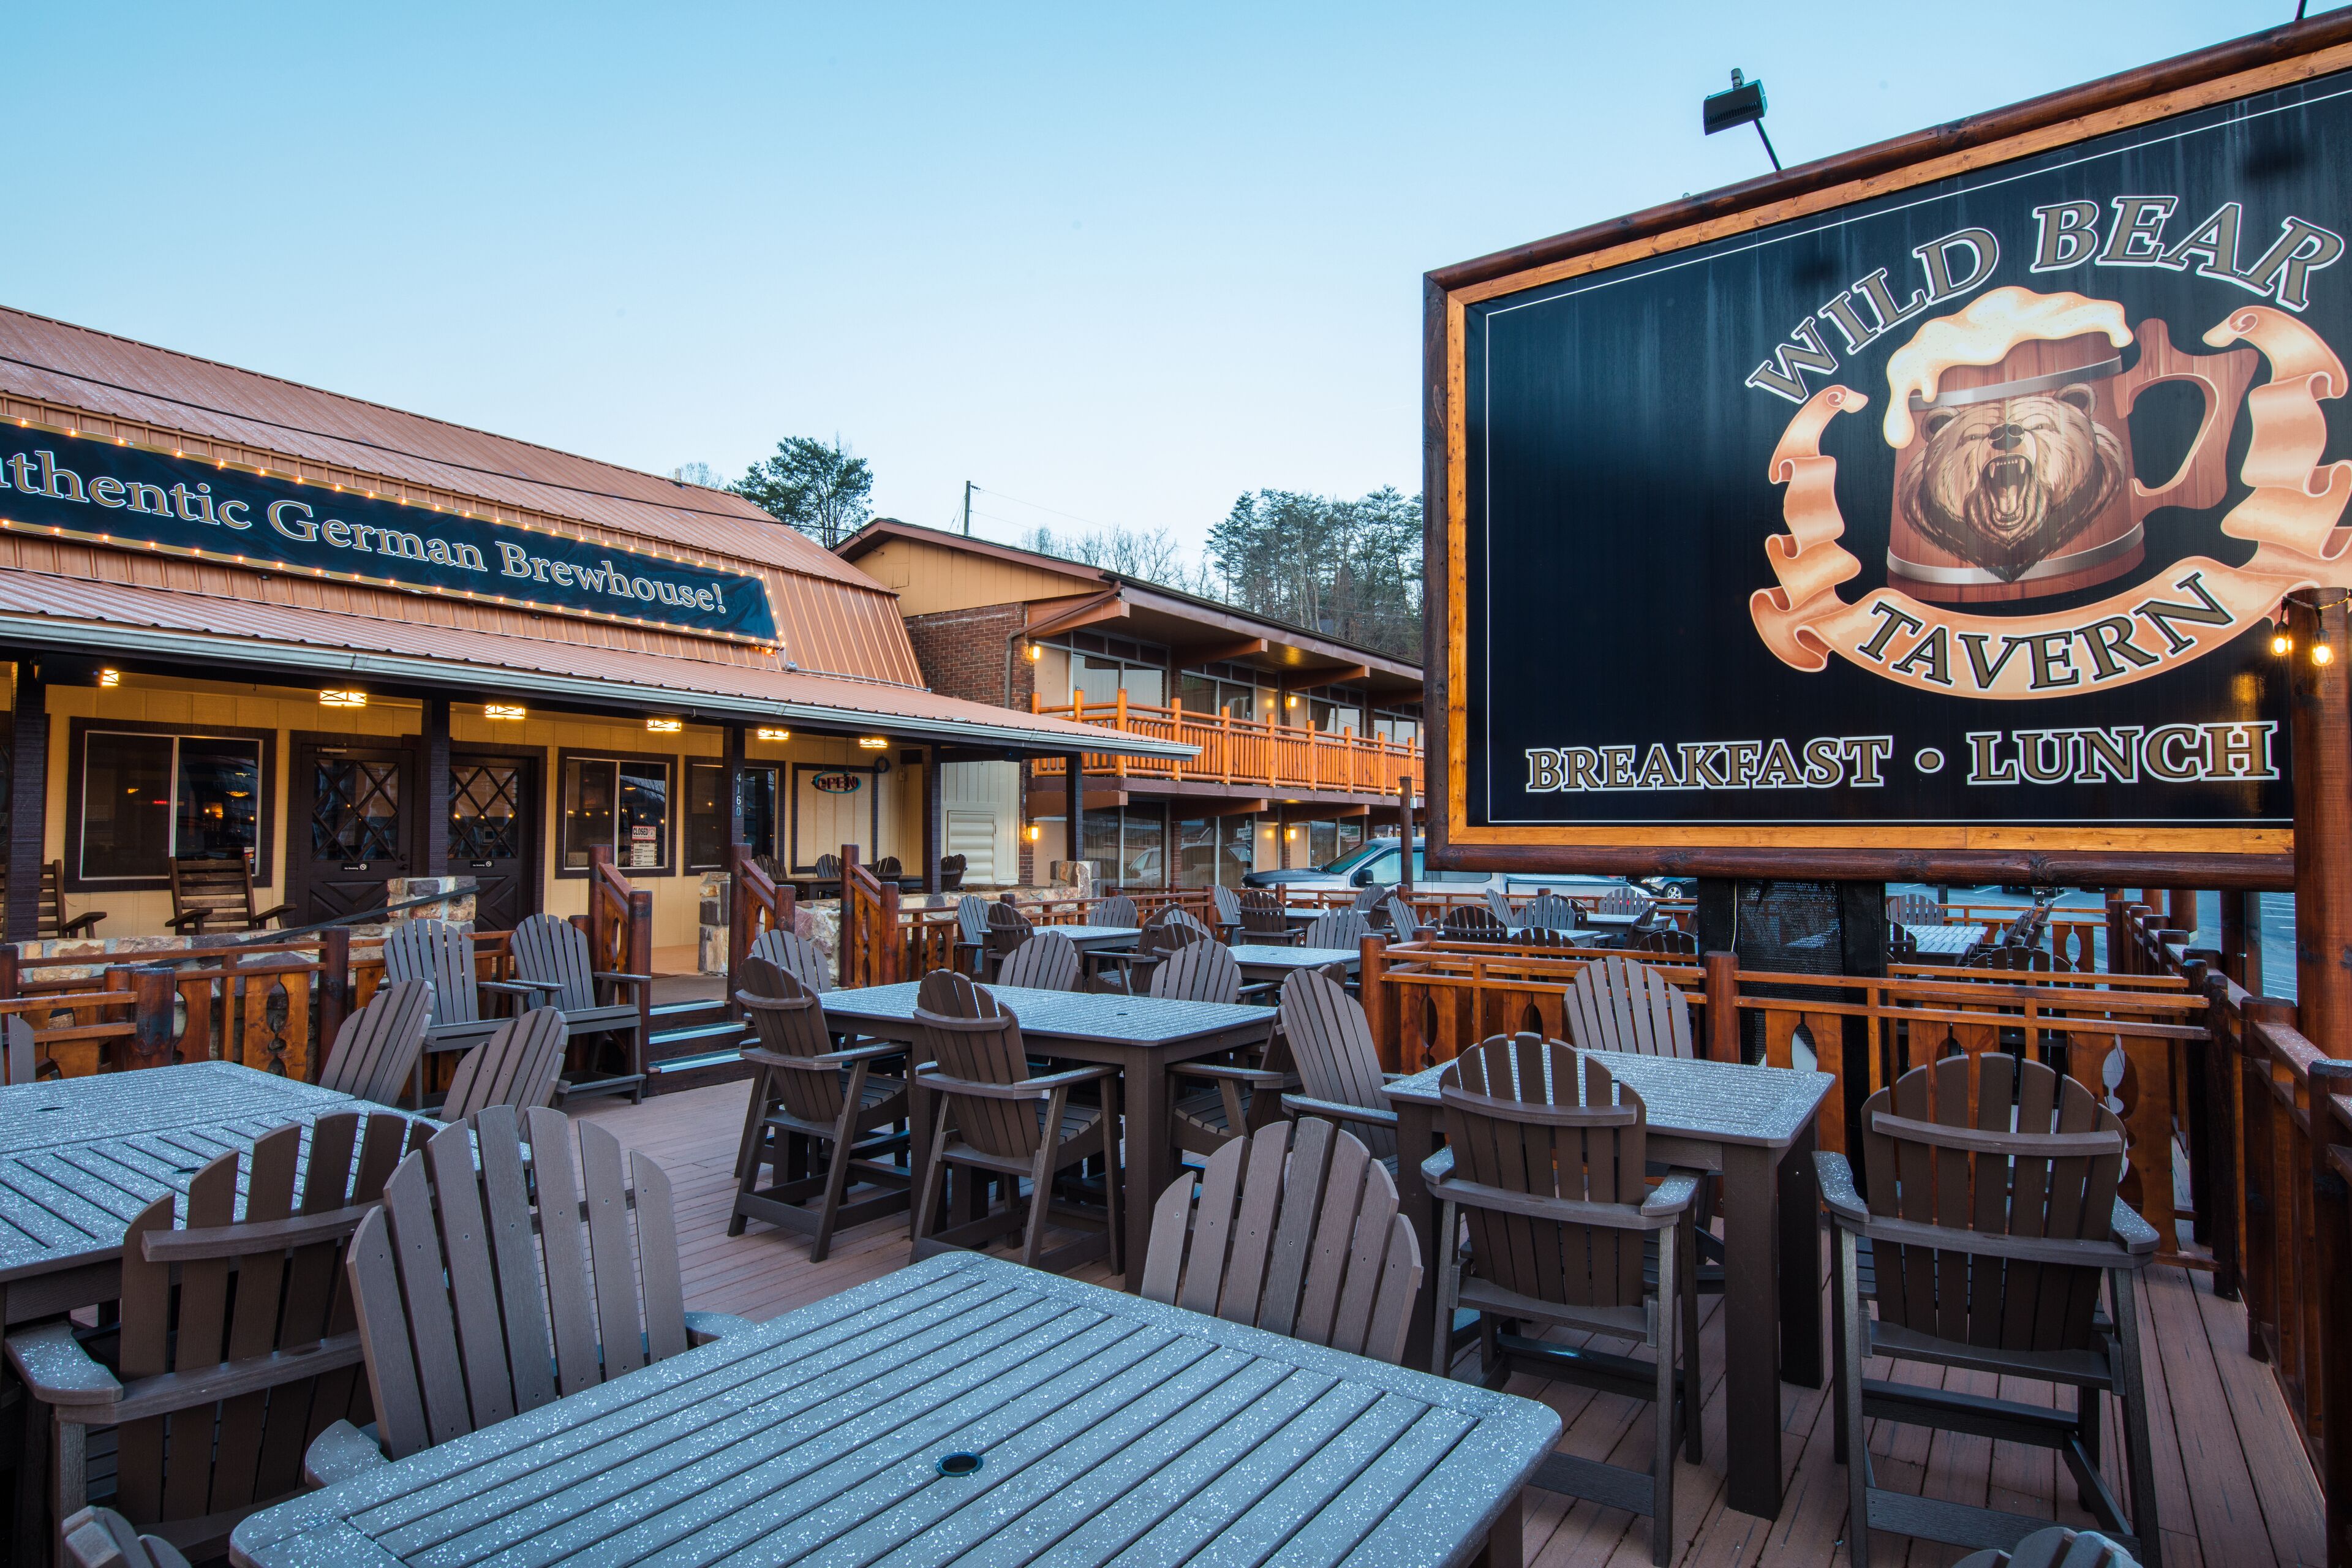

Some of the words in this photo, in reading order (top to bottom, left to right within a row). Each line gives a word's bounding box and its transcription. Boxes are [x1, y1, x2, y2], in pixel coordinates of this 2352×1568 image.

[1745, 227, 2000, 404] WILD
[2030, 195, 2344, 311] BEAR
[0, 450, 252, 530] thentic
[267, 500, 488, 571] German
[495, 541, 726, 613] Brewhouse!
[1857, 570, 2236, 691] TAVERN
[818, 776, 859, 790] OPEN
[1525, 736, 1892, 792] BREAKFAST
[1967, 720, 2278, 783] LUNCH
